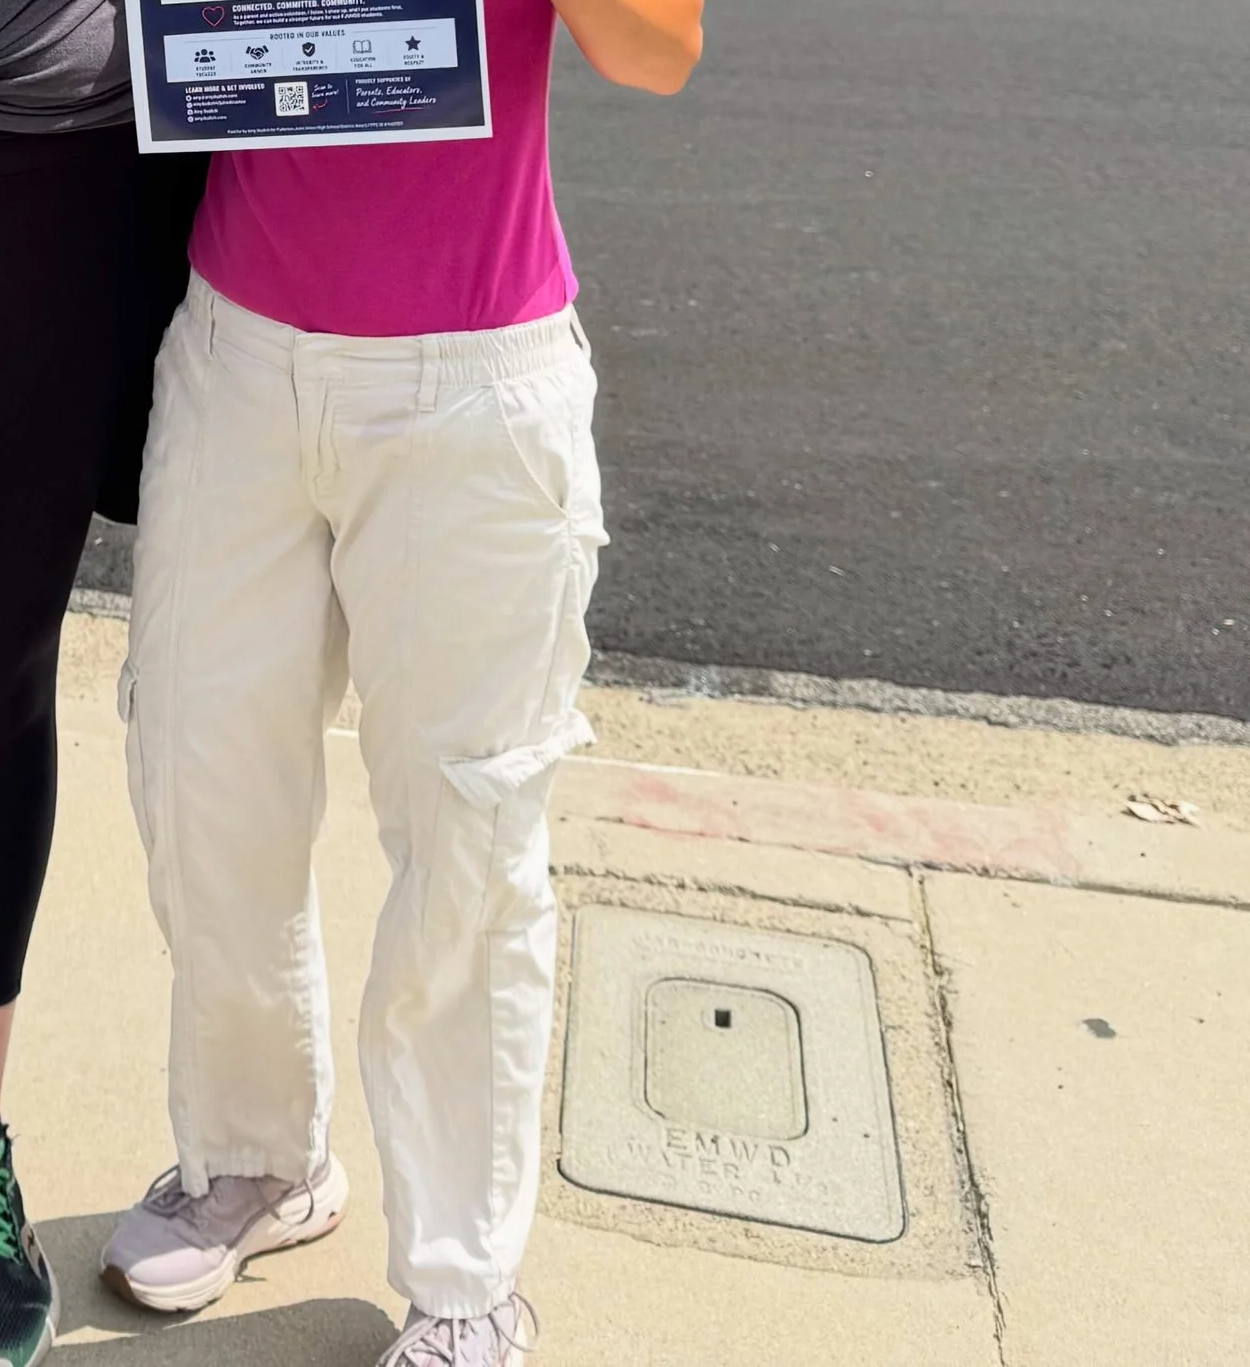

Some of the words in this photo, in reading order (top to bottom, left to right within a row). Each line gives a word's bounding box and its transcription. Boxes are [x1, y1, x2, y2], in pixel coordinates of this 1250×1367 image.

[232, 3, 274, 12] CONNECTED.
[276, 0, 319, 10] COMMITTED.
[270, 33, 295, 41] ROOTED
[355, 87, 383, 96] Parents,
[385, 84, 422, 95] Educators,
[370, 96, 407, 110] Community
[408, 94, 436, 104] Leaders
[666, 1128, 791, 1167] EMWD
